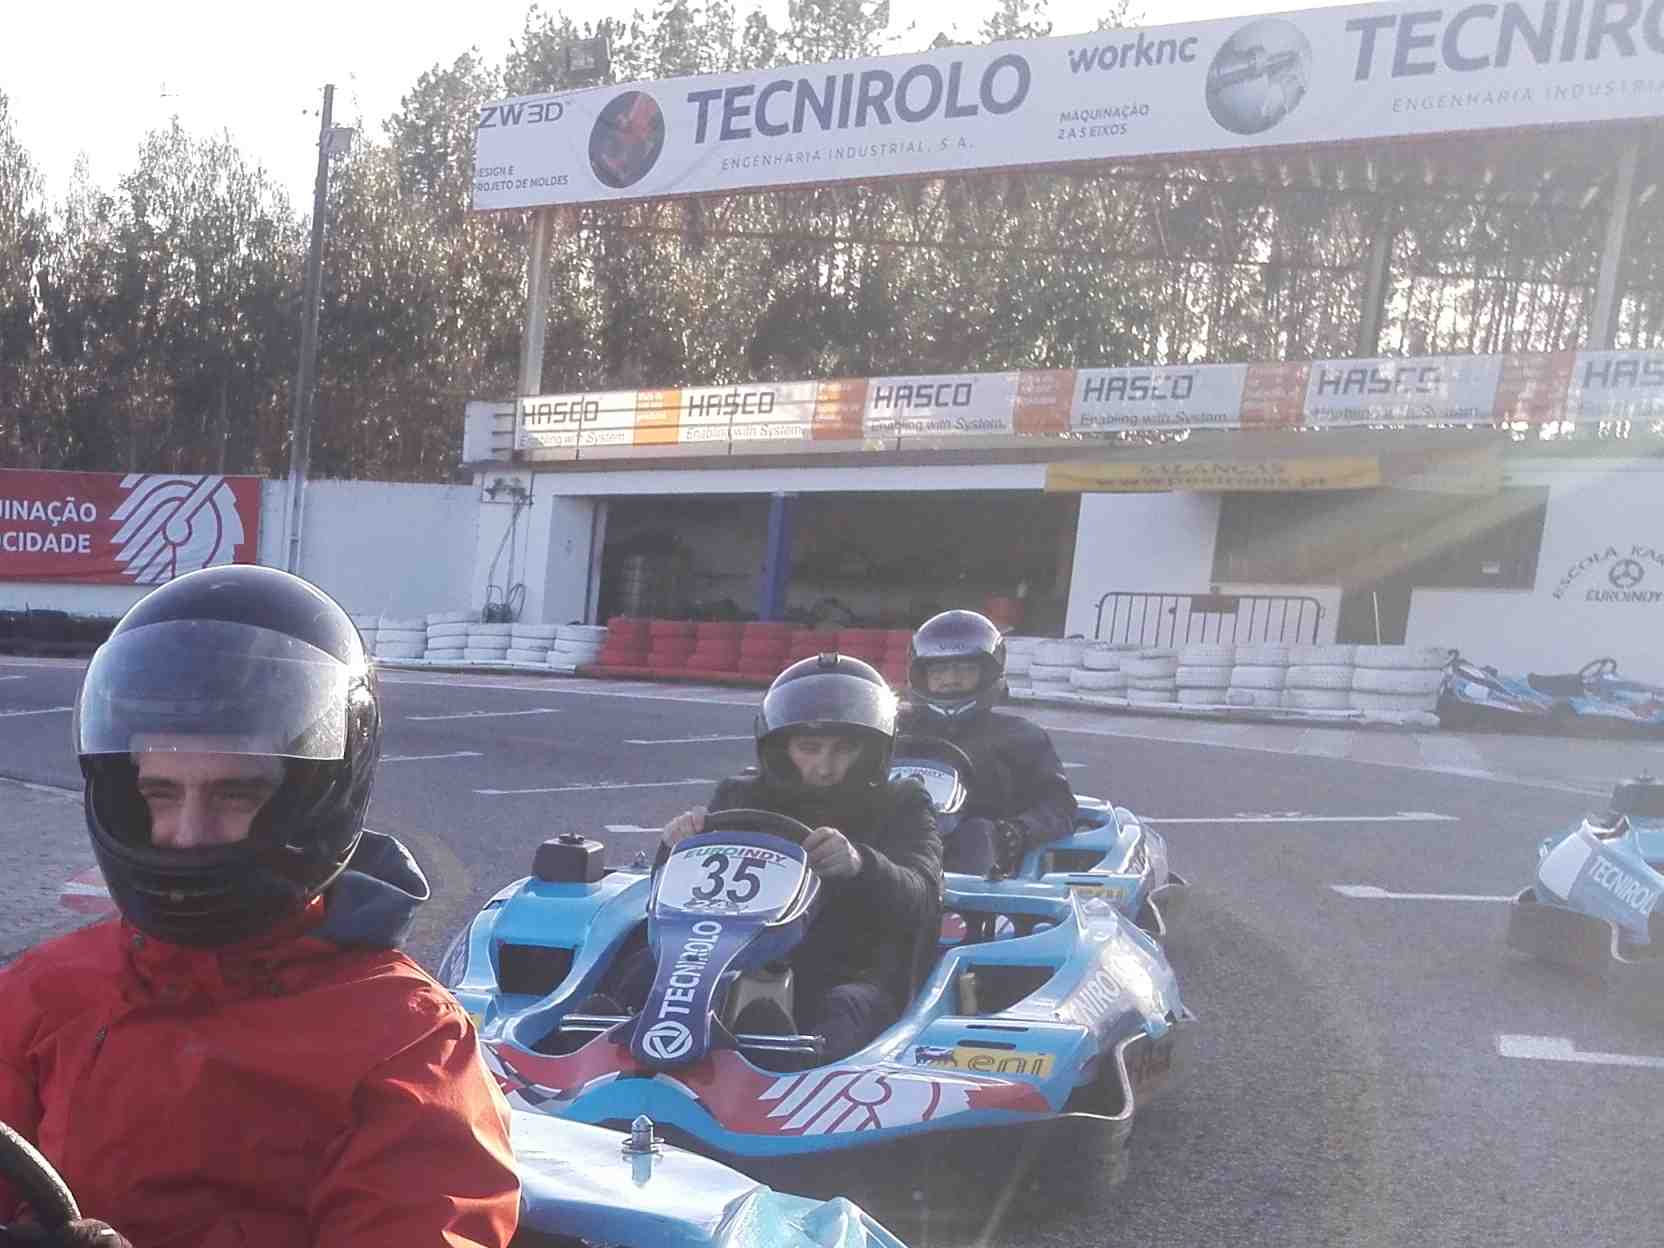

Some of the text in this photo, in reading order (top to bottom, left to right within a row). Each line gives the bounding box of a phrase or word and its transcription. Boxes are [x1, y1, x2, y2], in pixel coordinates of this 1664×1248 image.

[1068, 32, 1199, 74] worknc
[687, 53, 1031, 144] TECNIROLO
[1392, 87, 1534, 112] ENGENHARIA
[1089, 123, 1127, 138] EIXOS
[474, 167, 506, 178] ESIGN
[721, 150, 821, 171] ENGENHARIA
[530, 175, 569, 187] MOLDES
[874, 384, 973, 408] HASCO
[1082, 375, 1194, 402] HASCO
[522, 401, 599, 426] HASCO
[687, 392, 776, 418] HASCO
[692, 853, 767, 903] 35
[658, 920, 722, 1019] TECNIROLO
[967, 1051, 1046, 1076] eni
